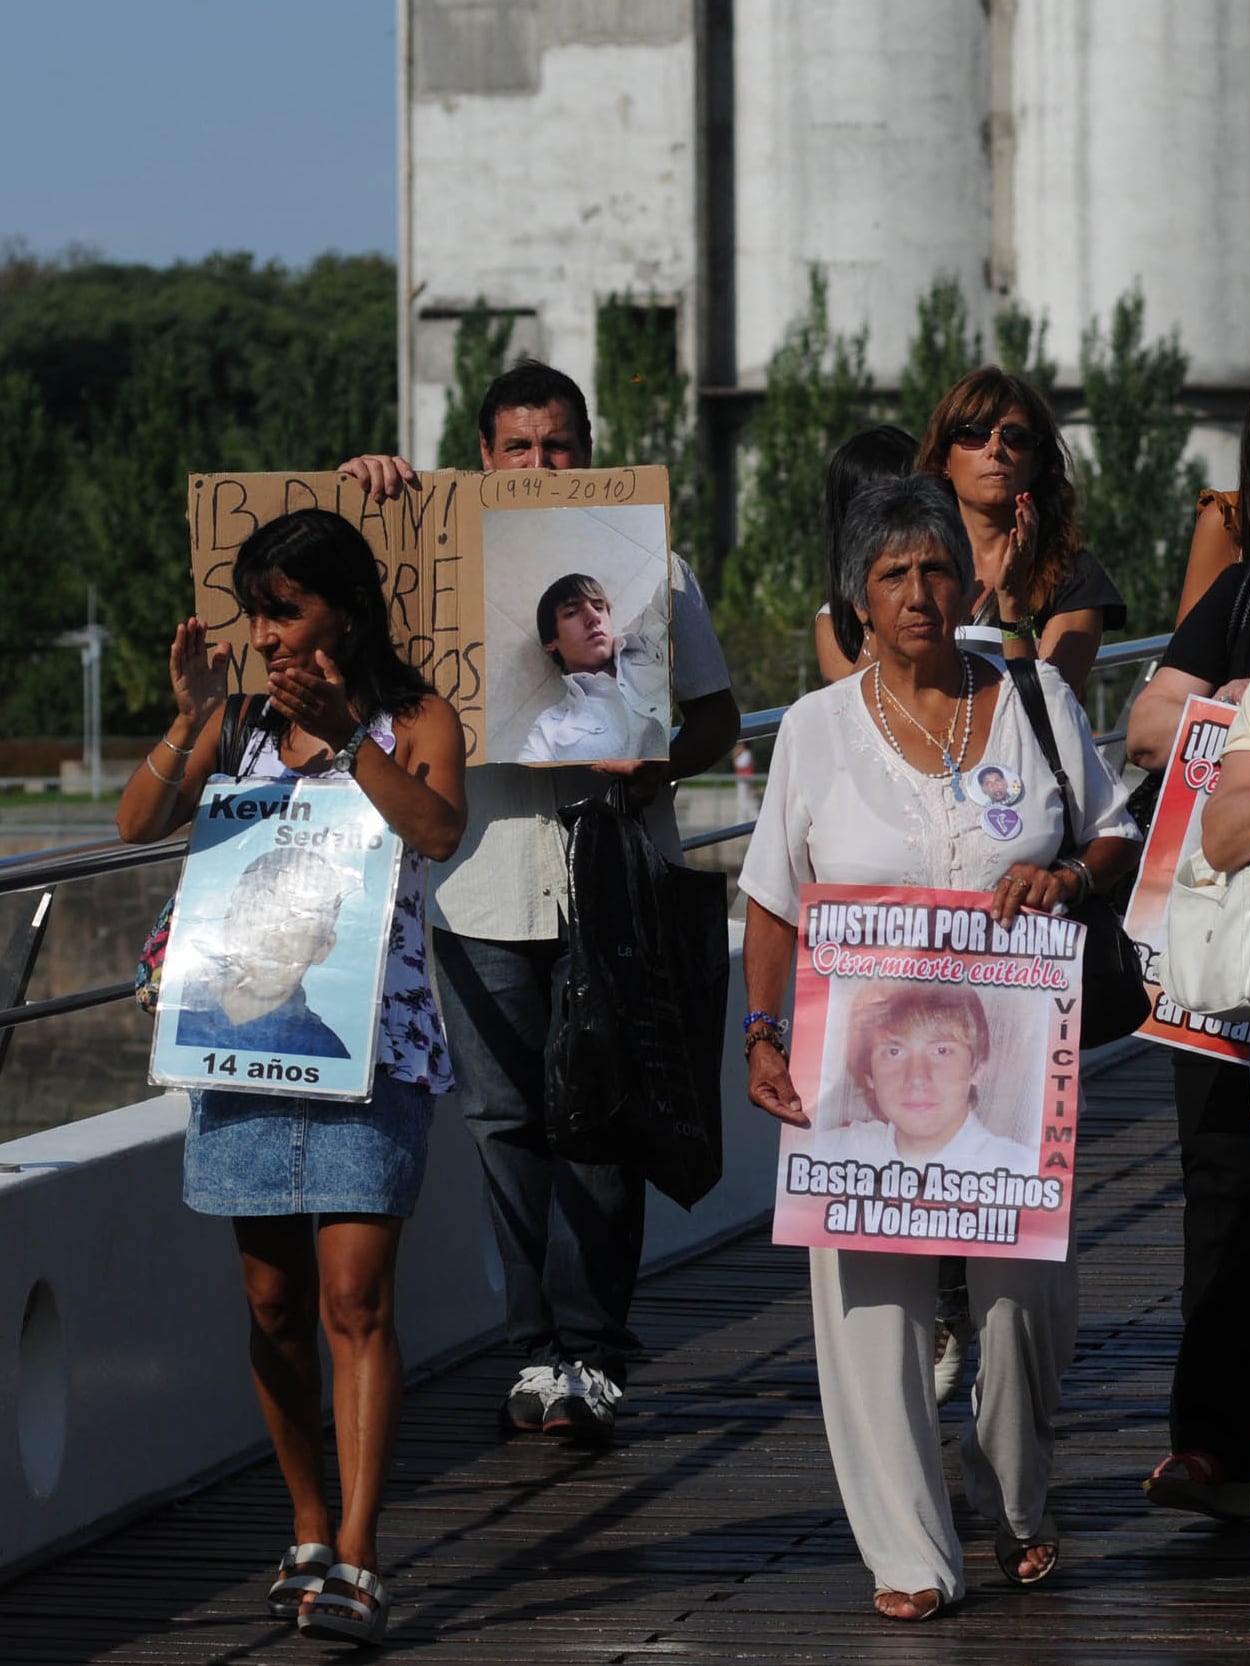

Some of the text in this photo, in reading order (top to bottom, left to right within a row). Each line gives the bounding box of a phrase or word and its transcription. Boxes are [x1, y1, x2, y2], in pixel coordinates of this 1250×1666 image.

[208, 793, 312, 821] Kevin
[808, 903, 1078, 958] ¡JUSTICIA POR BRIAN!
[812, 941, 1070, 989] Otra muerte evitable.
[202, 1052, 321, 1083] 14 años
[788, 1156, 1061, 1209] Basta de Asesinos
[827, 1199, 1017, 1243] al Volante!!!!
